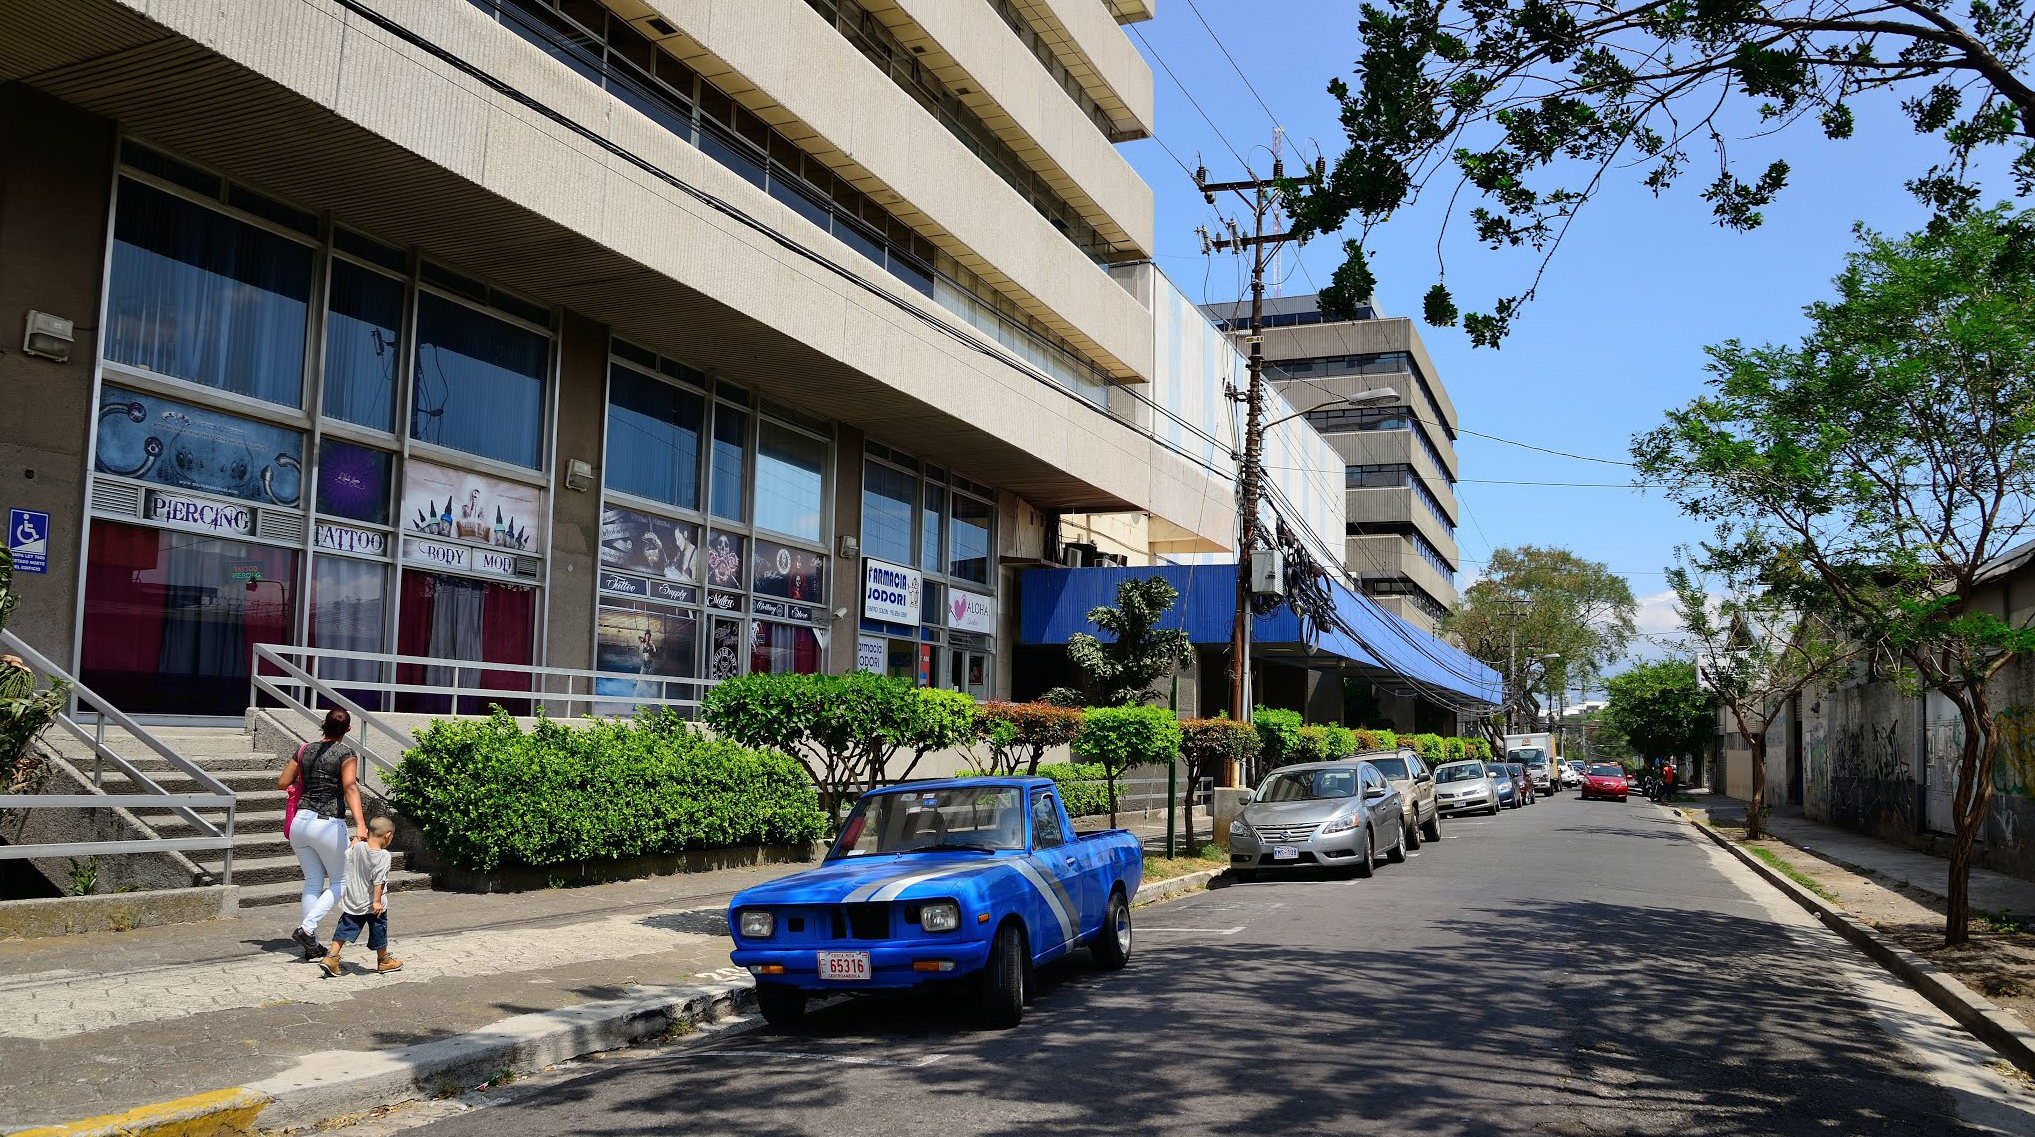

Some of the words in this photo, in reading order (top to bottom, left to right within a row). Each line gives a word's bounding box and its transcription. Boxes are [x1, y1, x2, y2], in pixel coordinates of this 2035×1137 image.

[151, 496, 250, 530] PIERCING
[314, 524, 384, 552] TATTOO
[427, 545, 464, 565] BODY
[483, 554, 512, 573] MOD
[232, 571, 261, 579] PIERCING
[868, 566, 907, 591] FARMACIA
[606, 574, 636, 592] Tattoo
[658, 583, 688, 601] Supply
[867, 587, 906, 607] JODORI
[757, 600, 777, 615] Clothing
[790, 606, 809, 619] Store
[967, 601, 989, 617] ALOHA
[858, 642, 882, 654] armacia
[859, 655, 880, 668] ODORI
[830, 958, 864, 973] 65316
